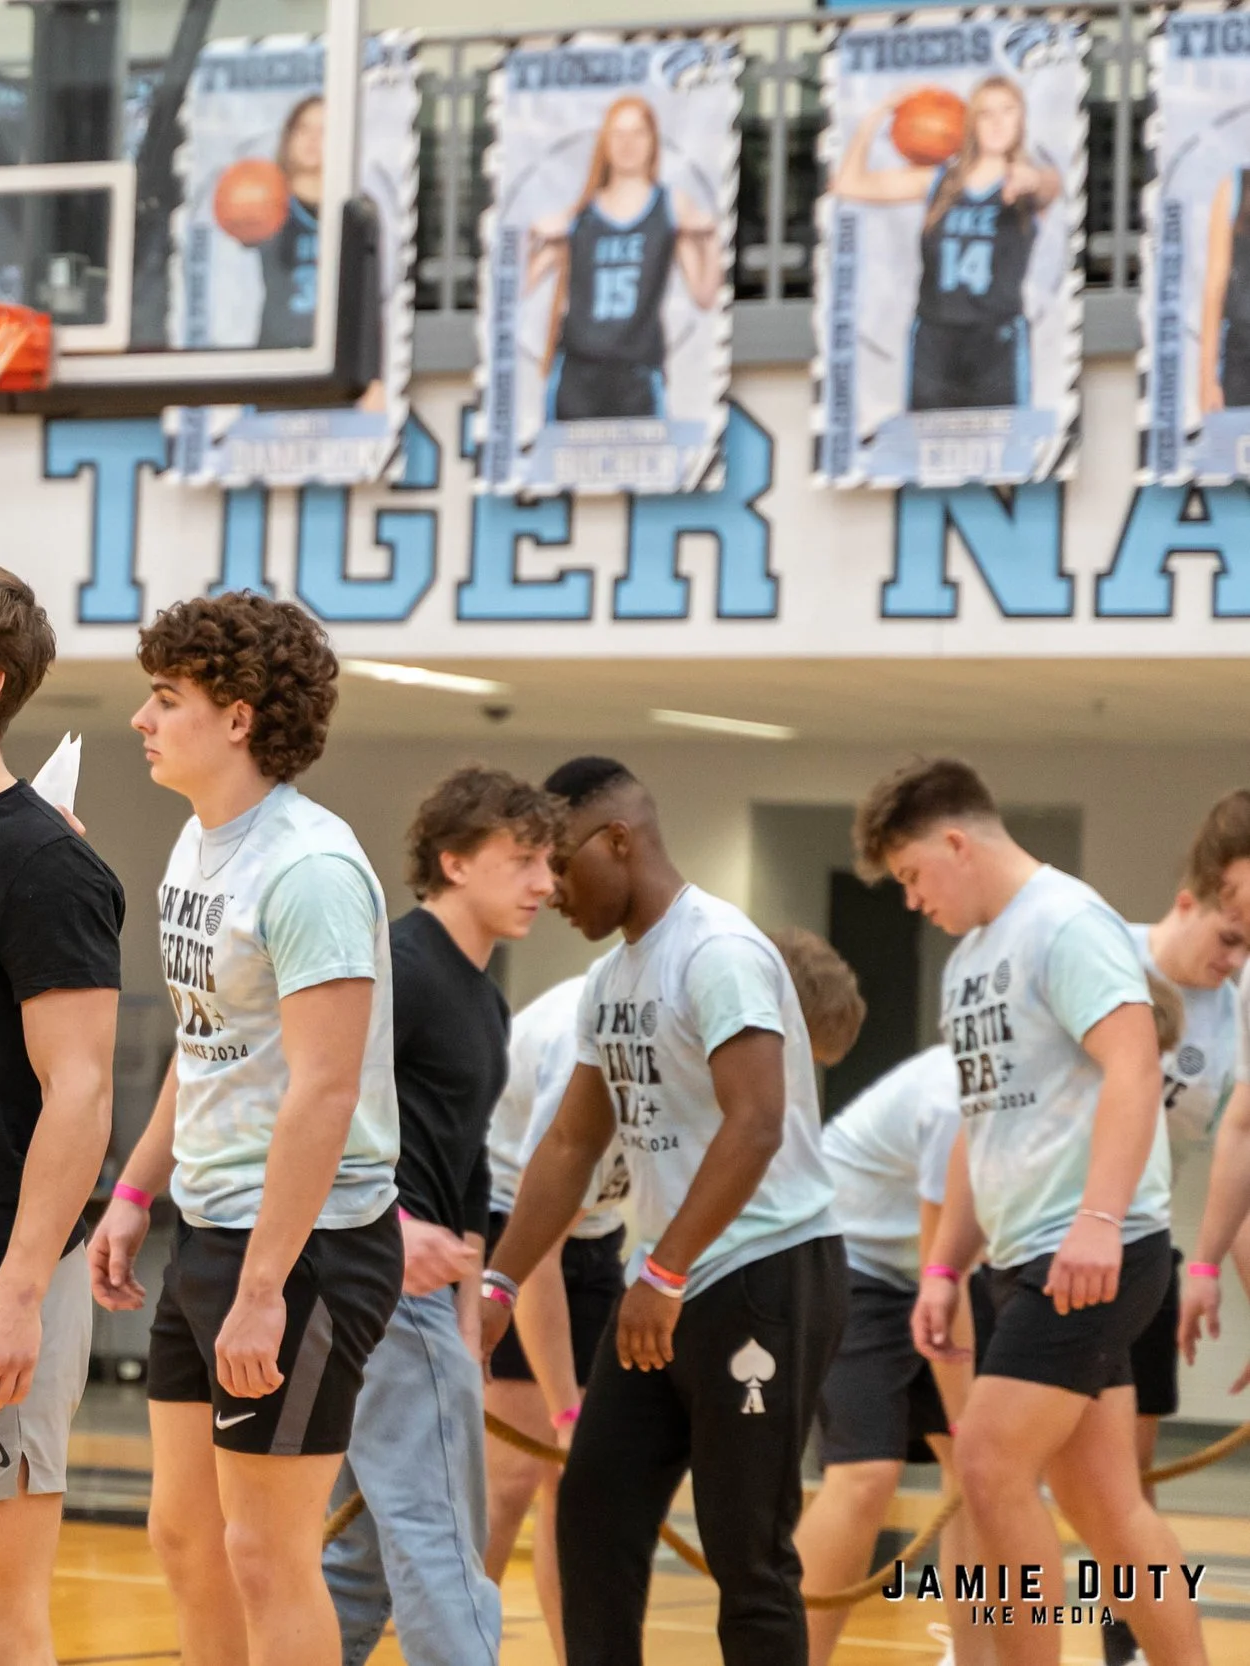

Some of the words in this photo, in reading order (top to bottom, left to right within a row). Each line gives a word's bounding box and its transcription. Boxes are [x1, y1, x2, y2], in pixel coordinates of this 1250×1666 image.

[850, 24, 992, 70] TIGERS
[943, 204, 1000, 238] IKE
[594, 231, 647, 262] IKE
[939, 237, 994, 296] 14
[592, 266, 642, 321] 15
[43, 404, 778, 623] TIGER
[177, 889, 209, 931] MY
[210, 1044, 249, 1062] 2024
